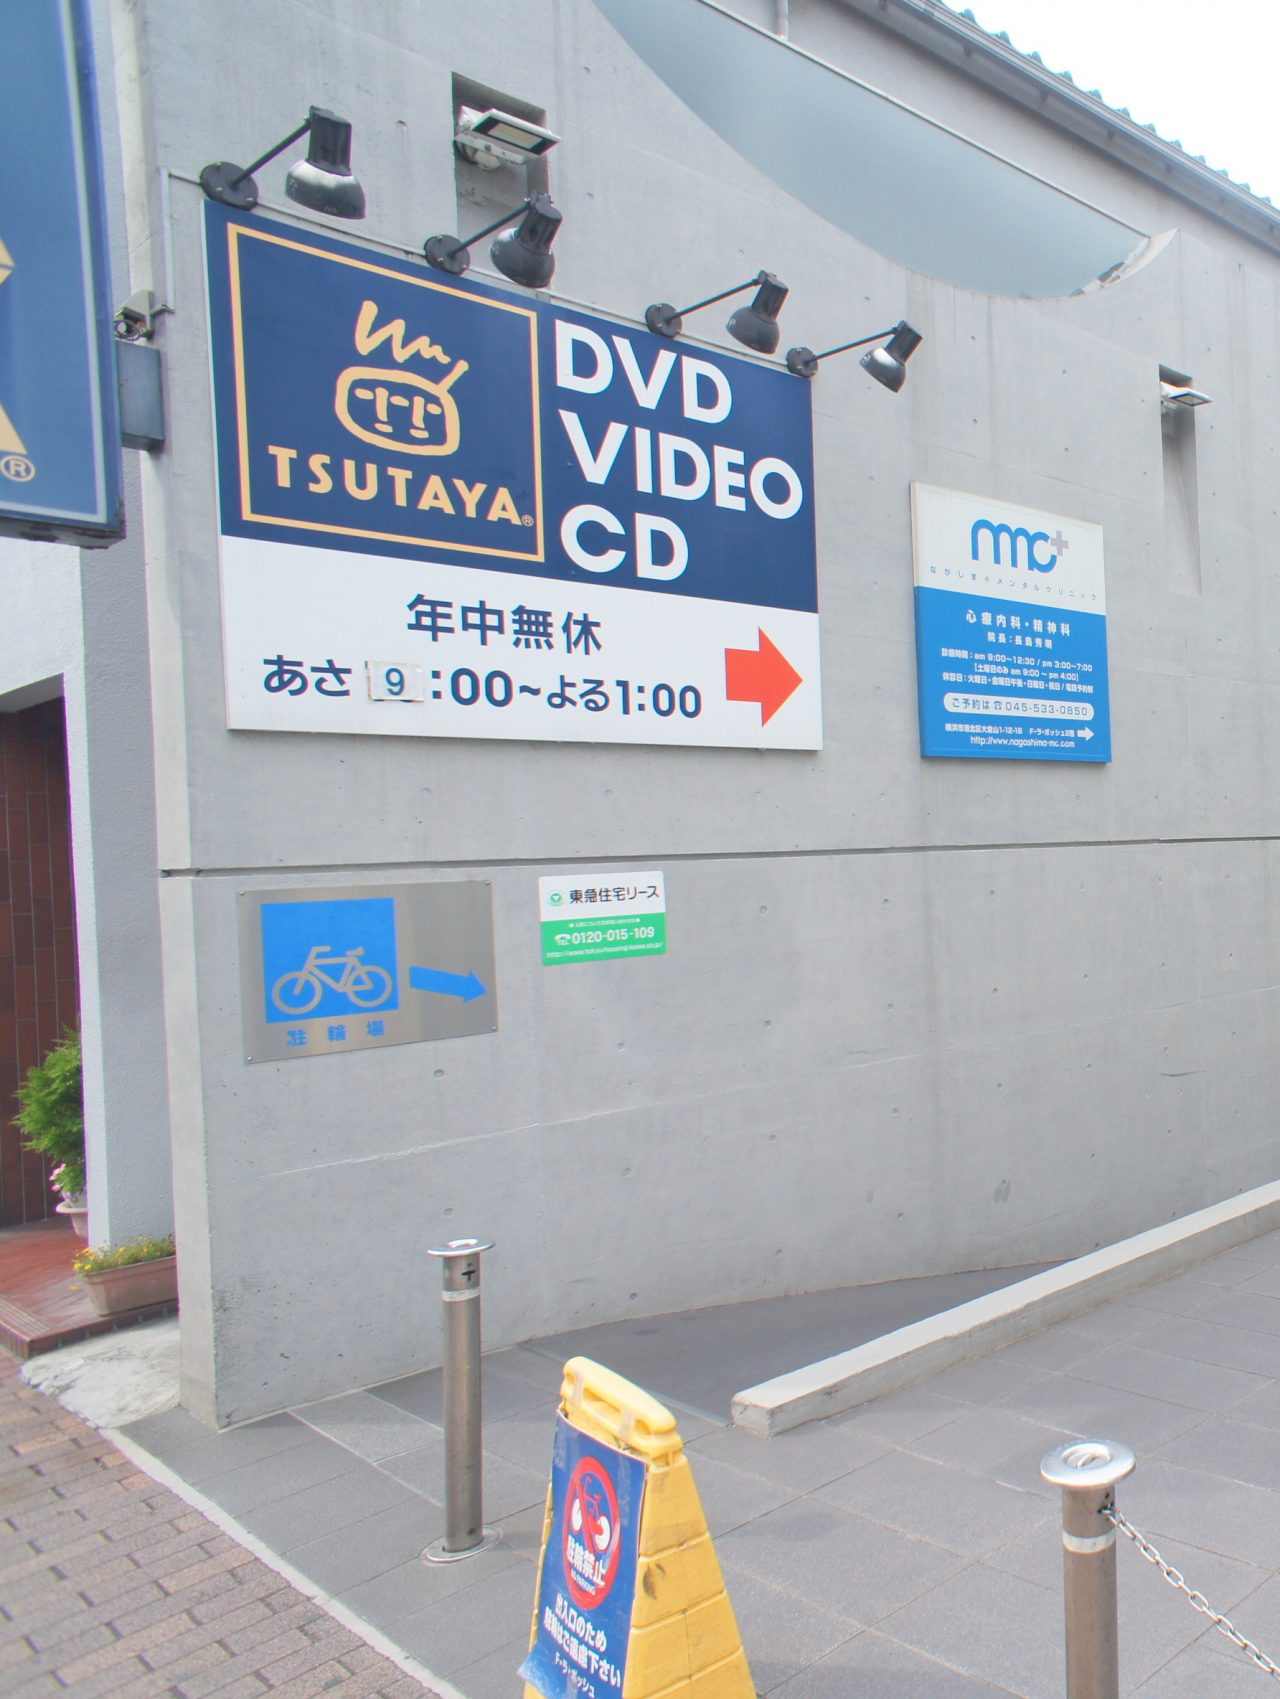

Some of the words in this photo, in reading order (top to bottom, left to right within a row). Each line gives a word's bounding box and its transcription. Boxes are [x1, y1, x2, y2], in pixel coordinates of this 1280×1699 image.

[554, 319, 733, 424] DVD
[267, 446, 522, 526] TSUTAYA
[558, 409, 804, 520] VIDEO
[560, 503, 689, 582] CD
[405, 594, 604, 656] 年中無休
[1005, 701, 1088, 716] 045-533-0850
[569, 885, 660, 904] 東急住宅リース
[571, 926, 655, 944] 0120-015-109
